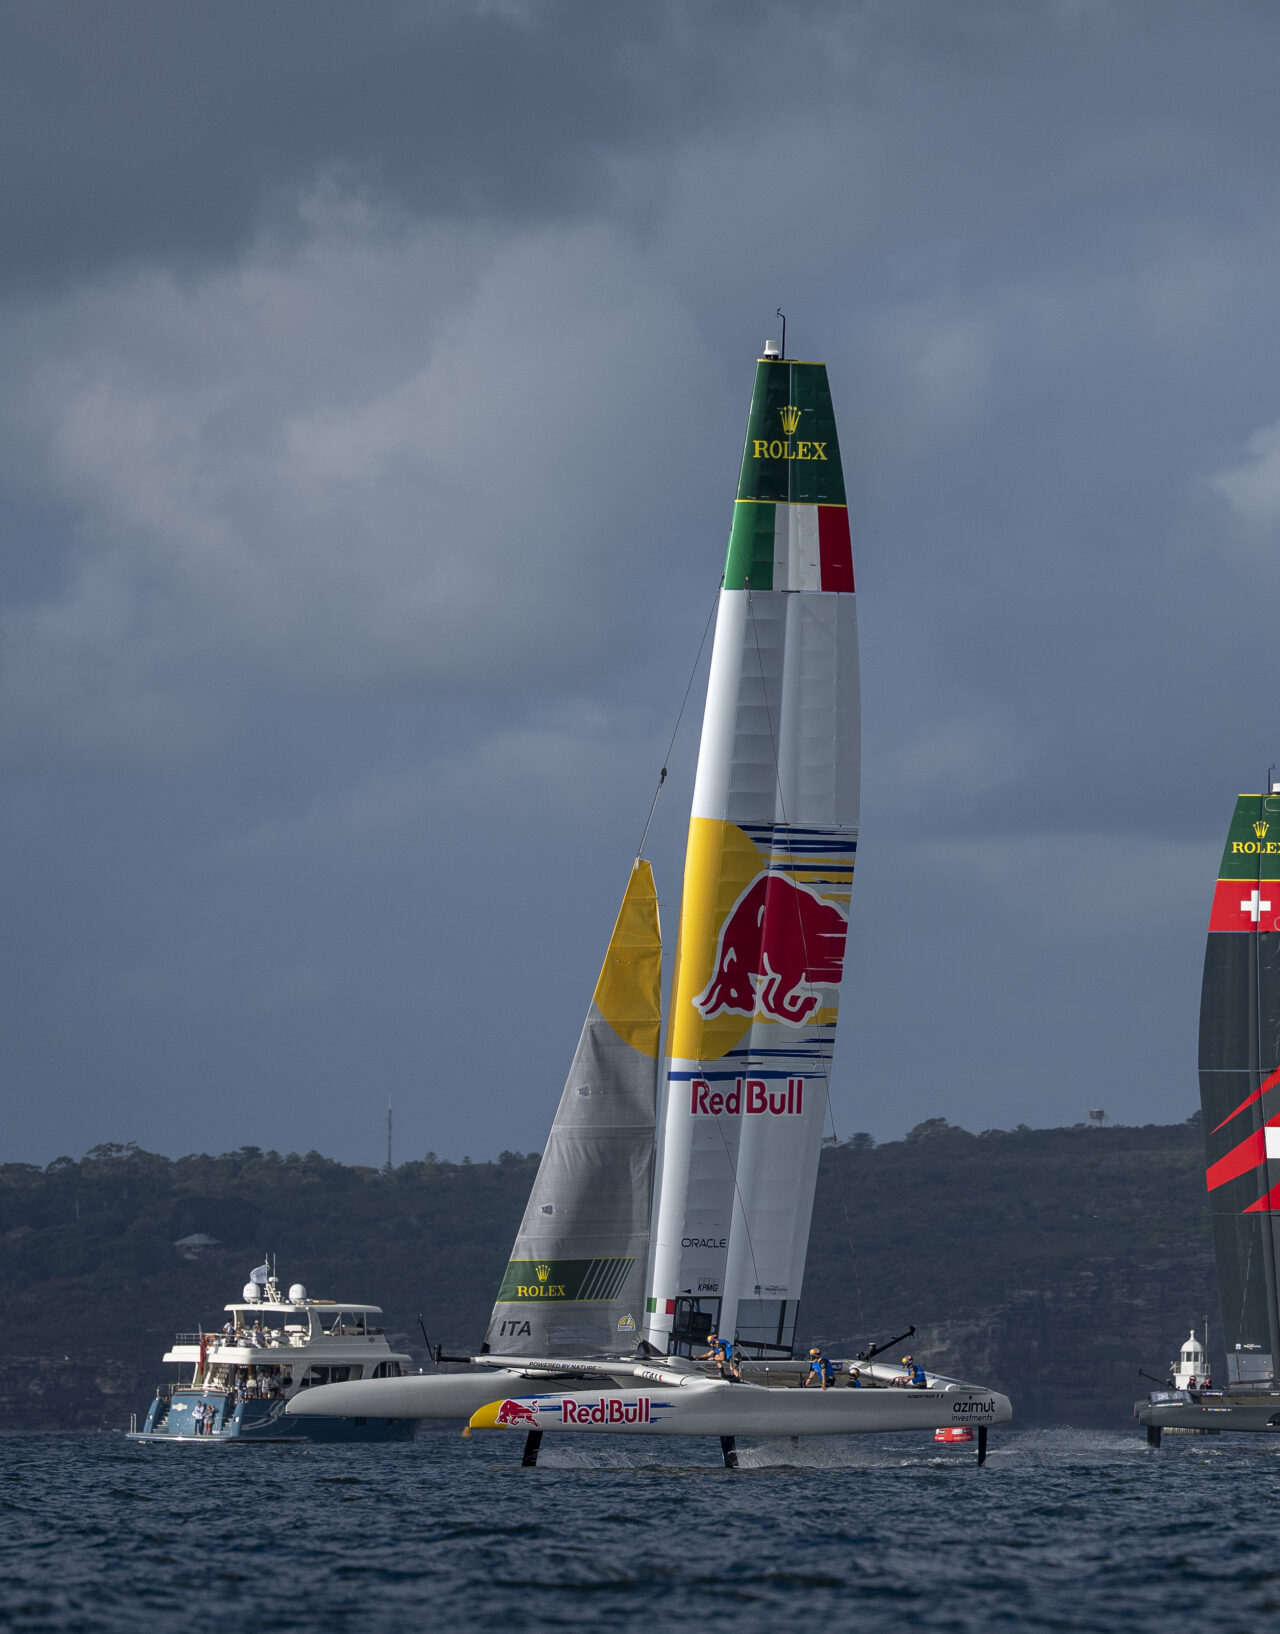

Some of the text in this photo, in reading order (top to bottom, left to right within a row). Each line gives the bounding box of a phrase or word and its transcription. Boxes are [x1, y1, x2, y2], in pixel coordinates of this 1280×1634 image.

[752, 440, 828, 460] ROLEX
[681, 1238, 727, 1248] ORACLE
[516, 1285, 566, 1297] ROLEX
[697, 1283, 718, 1292] KPMG
[500, 1321, 531, 1336] ITA
[529, 1361, 560, 1370] POWERED
[953, 1396, 995, 1412] azimut
